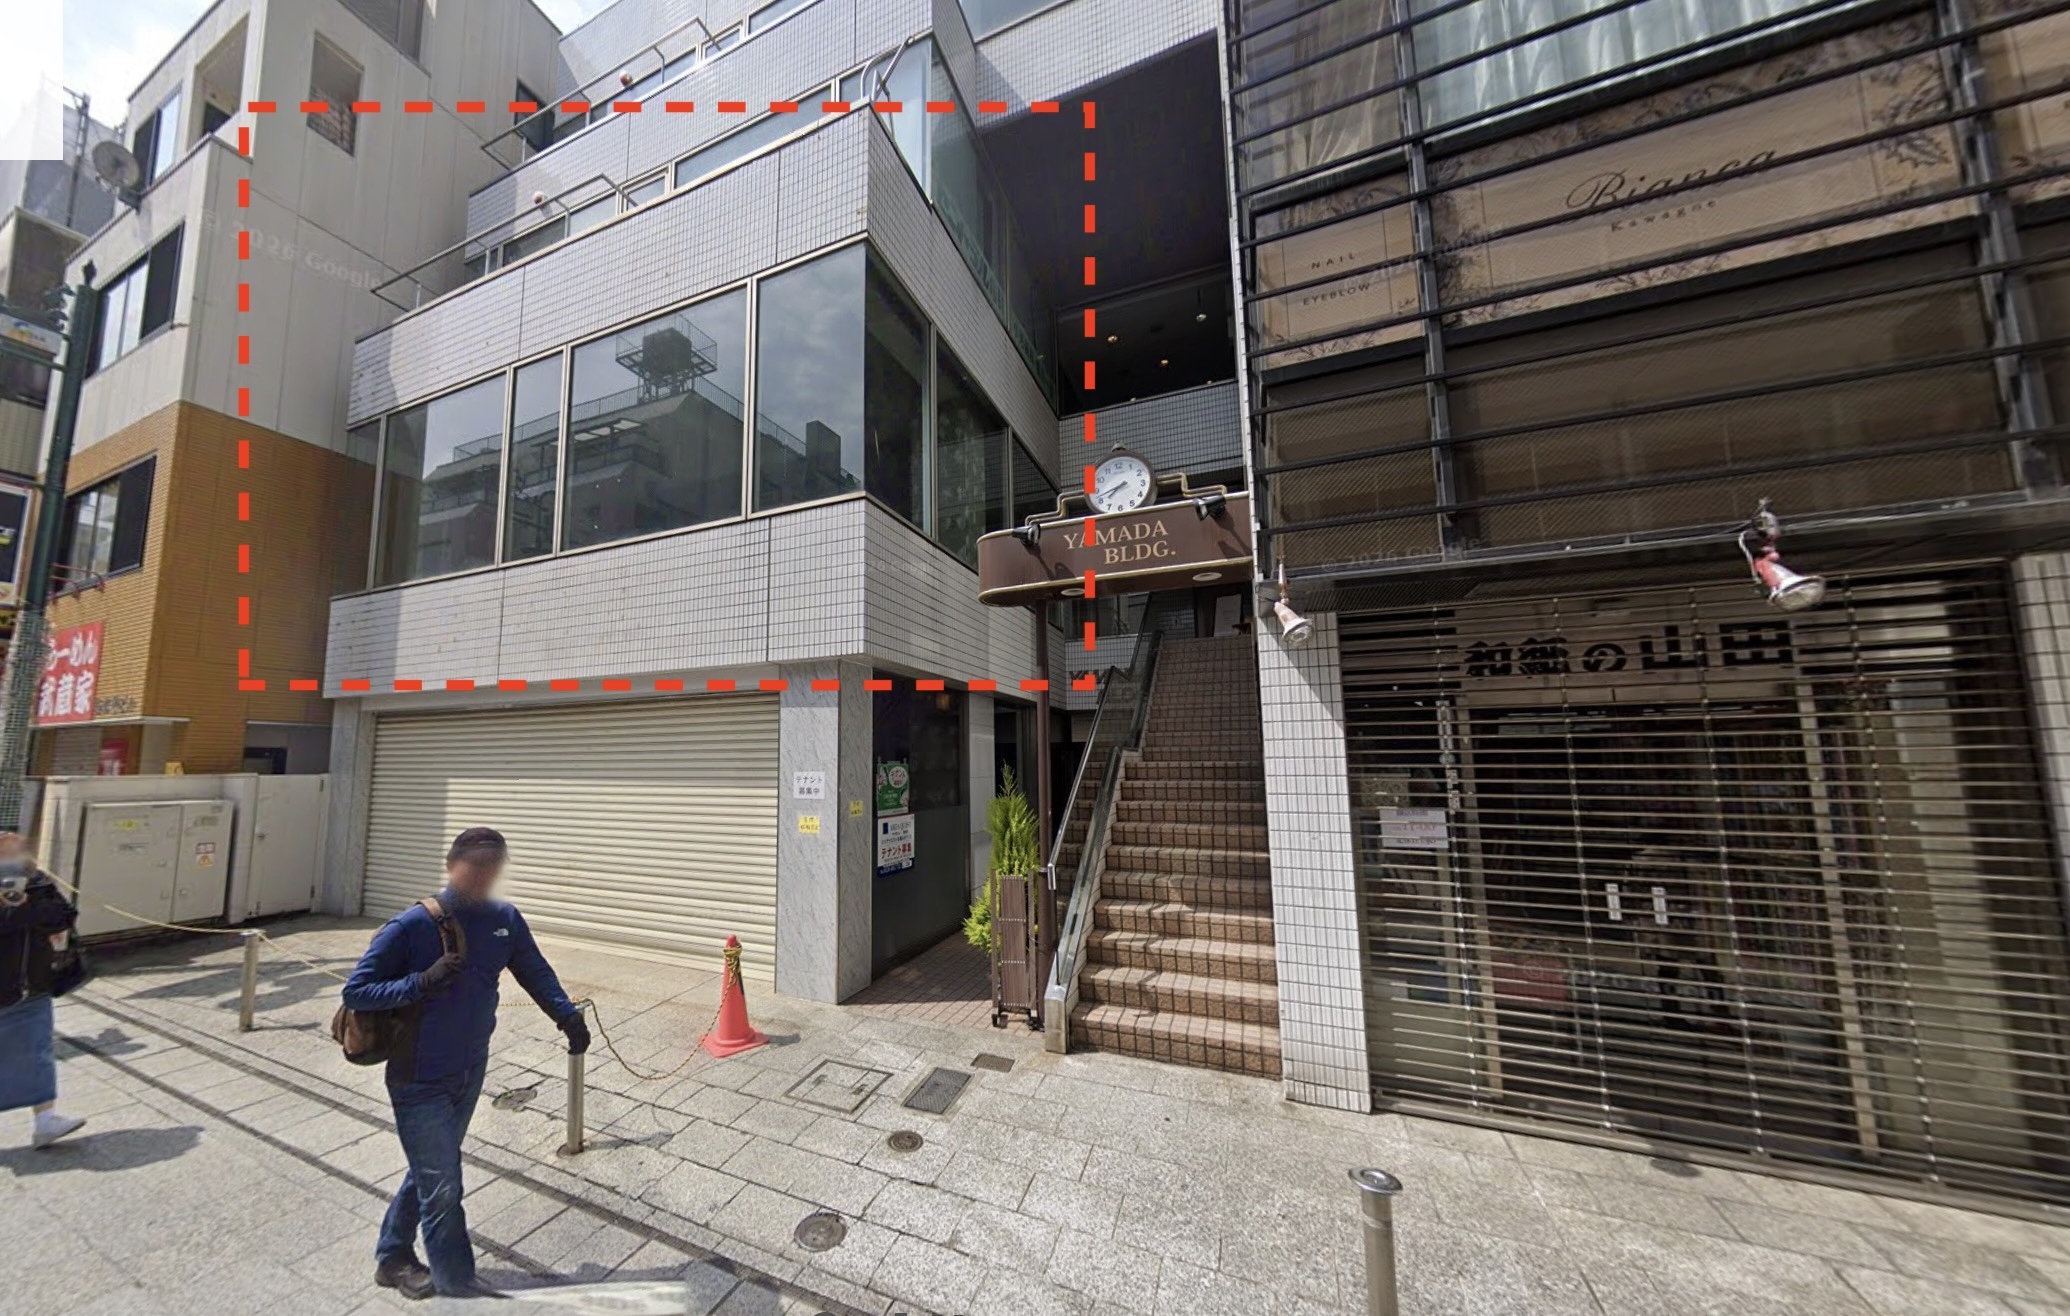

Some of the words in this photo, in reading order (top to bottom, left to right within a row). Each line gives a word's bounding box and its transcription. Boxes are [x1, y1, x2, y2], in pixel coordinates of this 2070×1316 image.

[1310, 252, 1355, 270] NAIL
[1302, 282, 1371, 306] EYEBLOW
[1104, 540, 1177, 565] BLDG.
[796, 775, 823, 784] テナント
[798, 787, 820, 796] 募集中
